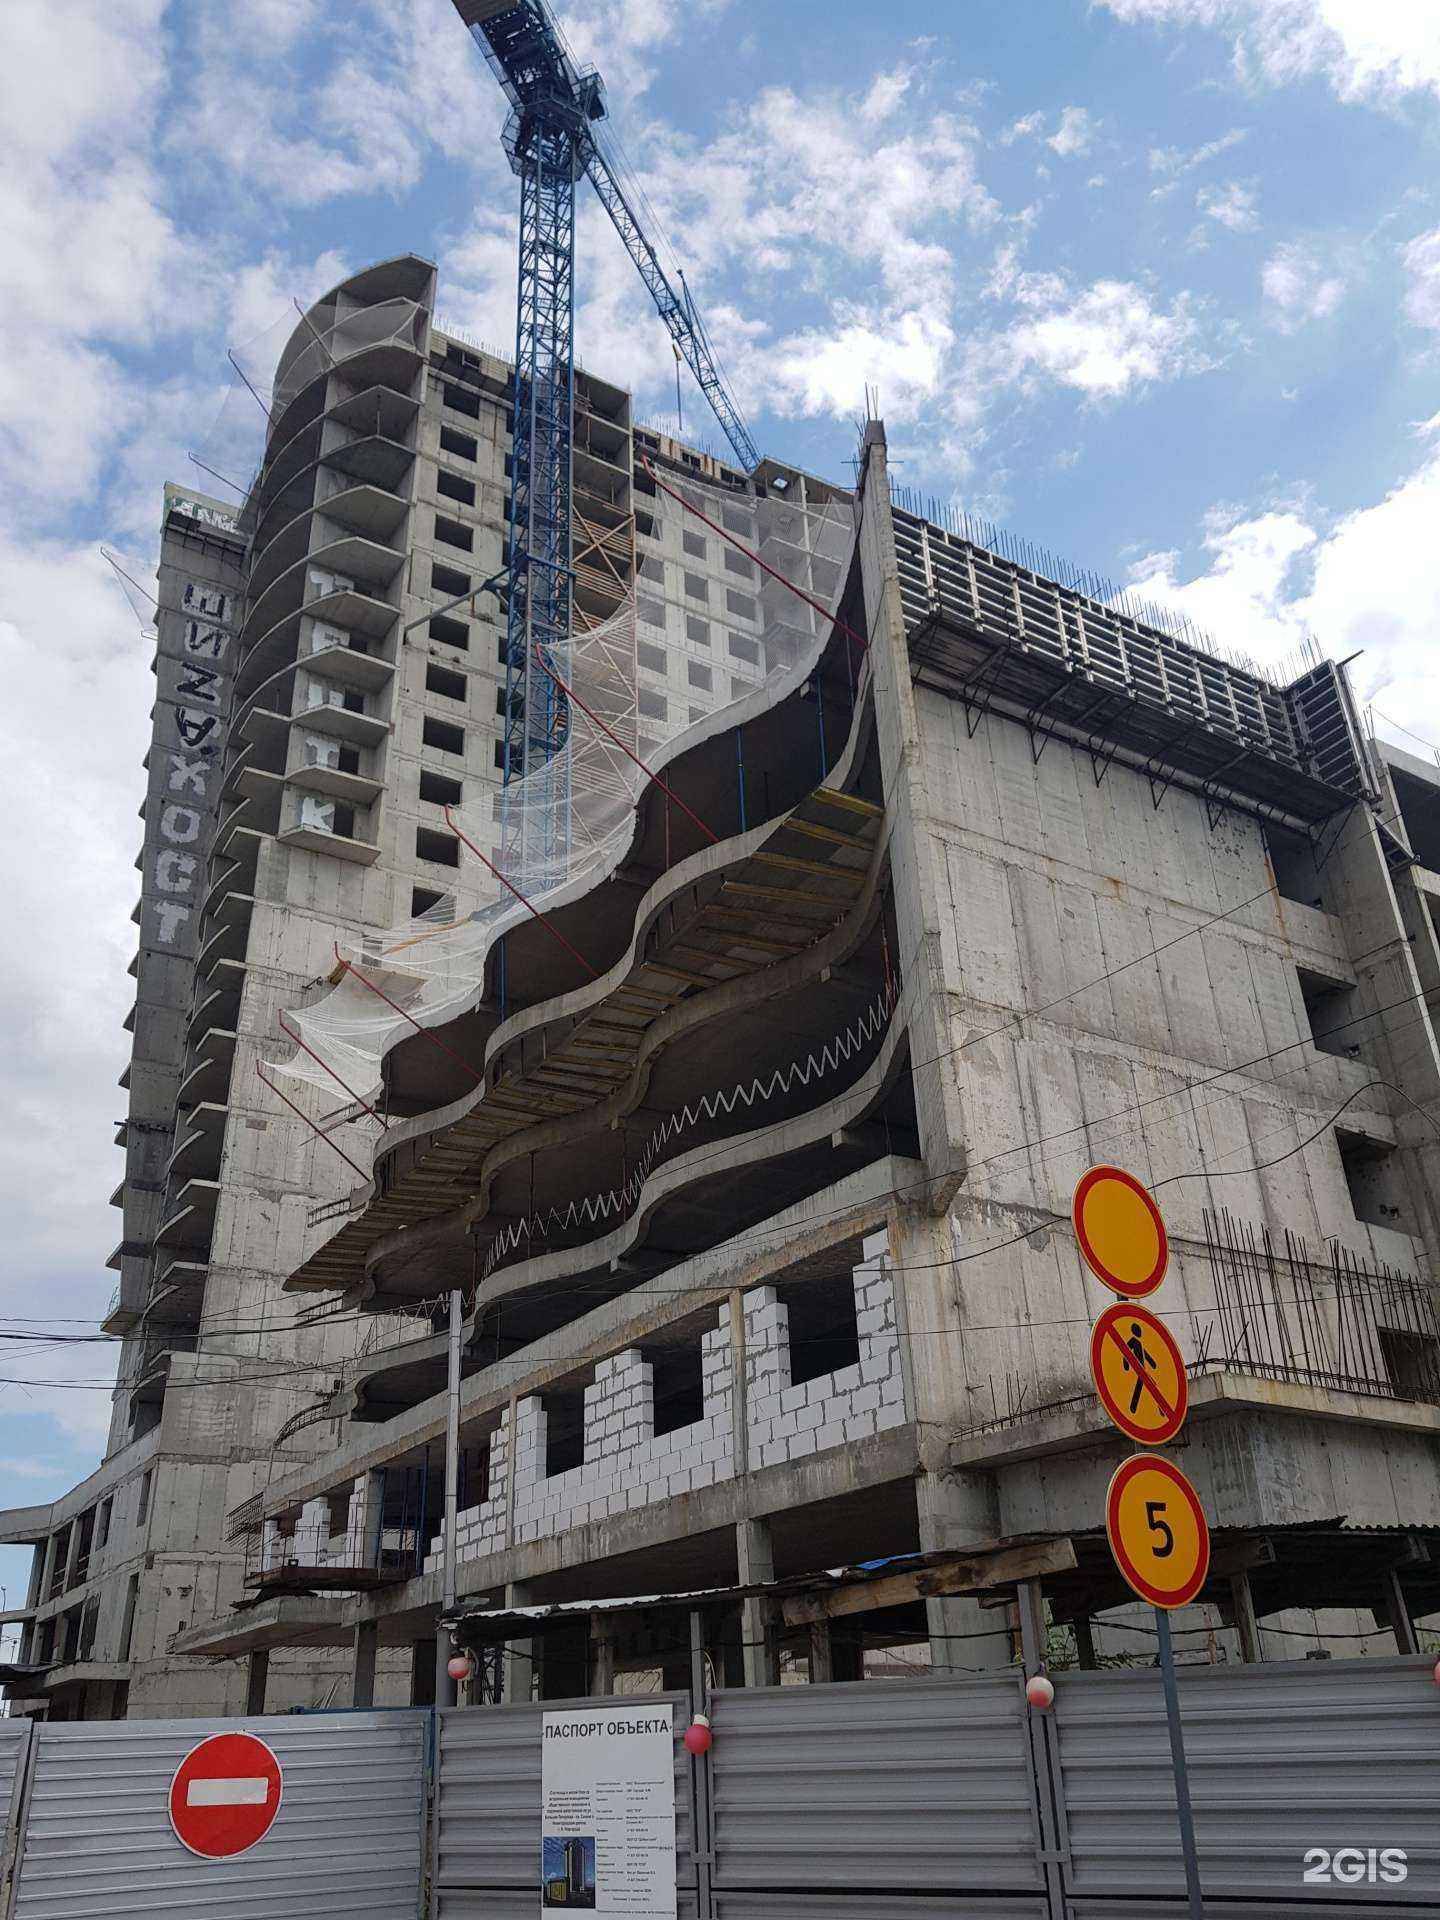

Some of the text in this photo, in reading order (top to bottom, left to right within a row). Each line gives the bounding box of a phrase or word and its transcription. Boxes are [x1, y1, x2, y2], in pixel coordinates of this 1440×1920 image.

[1145, 1501, 1174, 1558] 5
[545, 1719, 669, 1739] ПАСПОРТ ОБЪЕКТА
